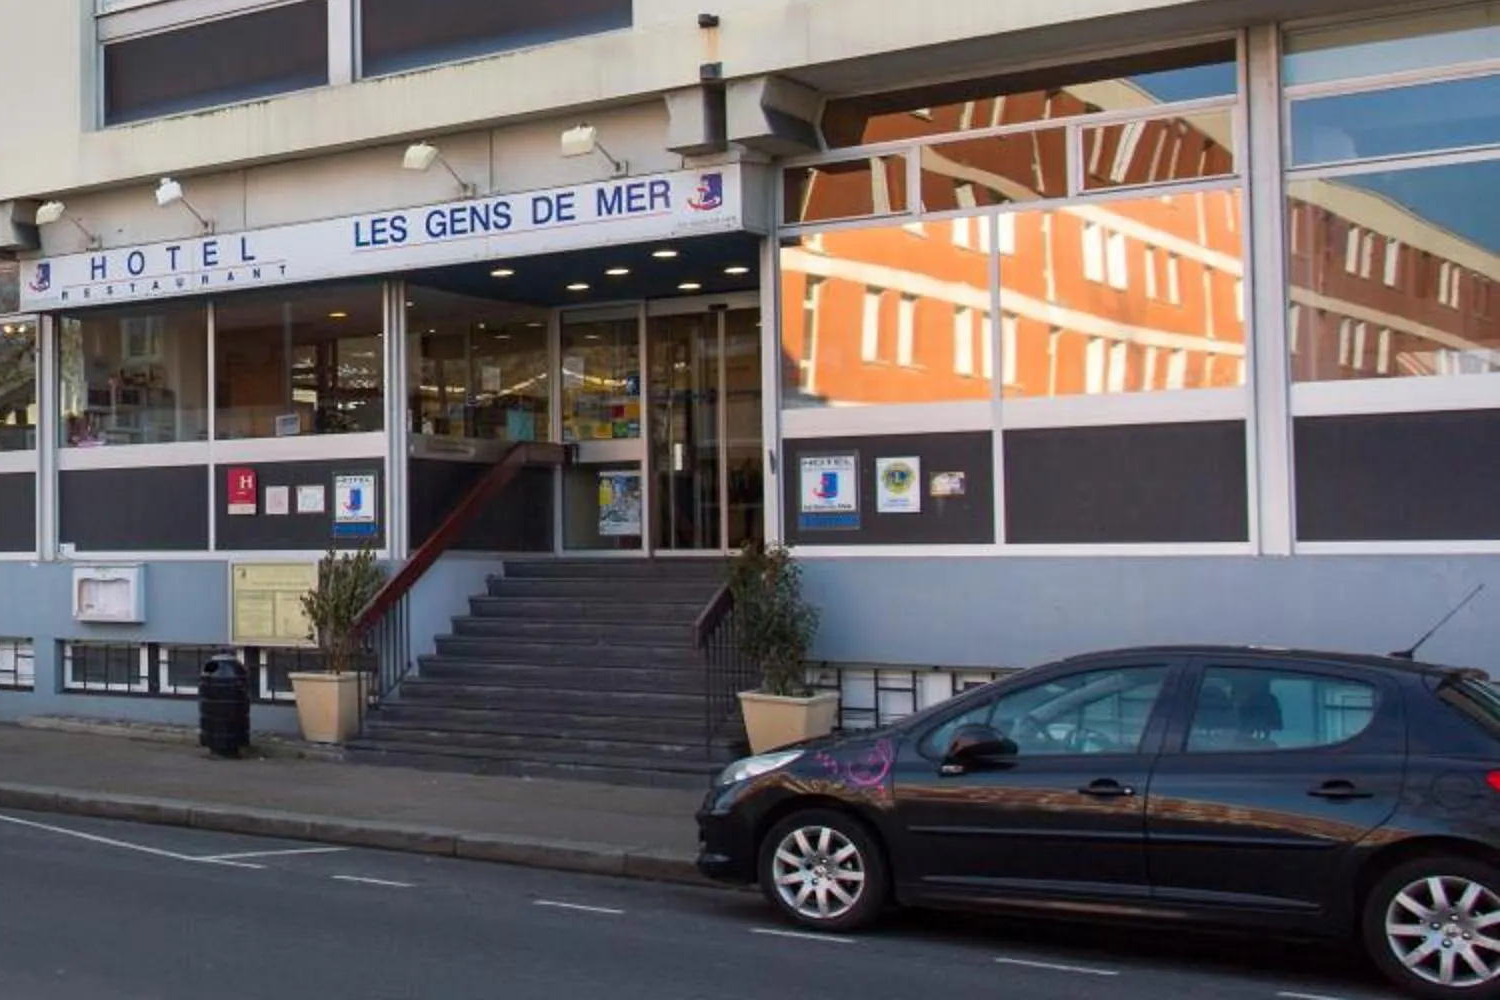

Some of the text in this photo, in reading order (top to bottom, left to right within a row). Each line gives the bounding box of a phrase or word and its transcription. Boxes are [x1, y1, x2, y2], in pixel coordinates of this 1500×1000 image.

[354, 179, 670, 247] LES GENS DE MER
[90, 237, 256, 280] HOTEL
[61, 265, 287, 301] RESTAURANT
[240, 475, 253, 489] H
